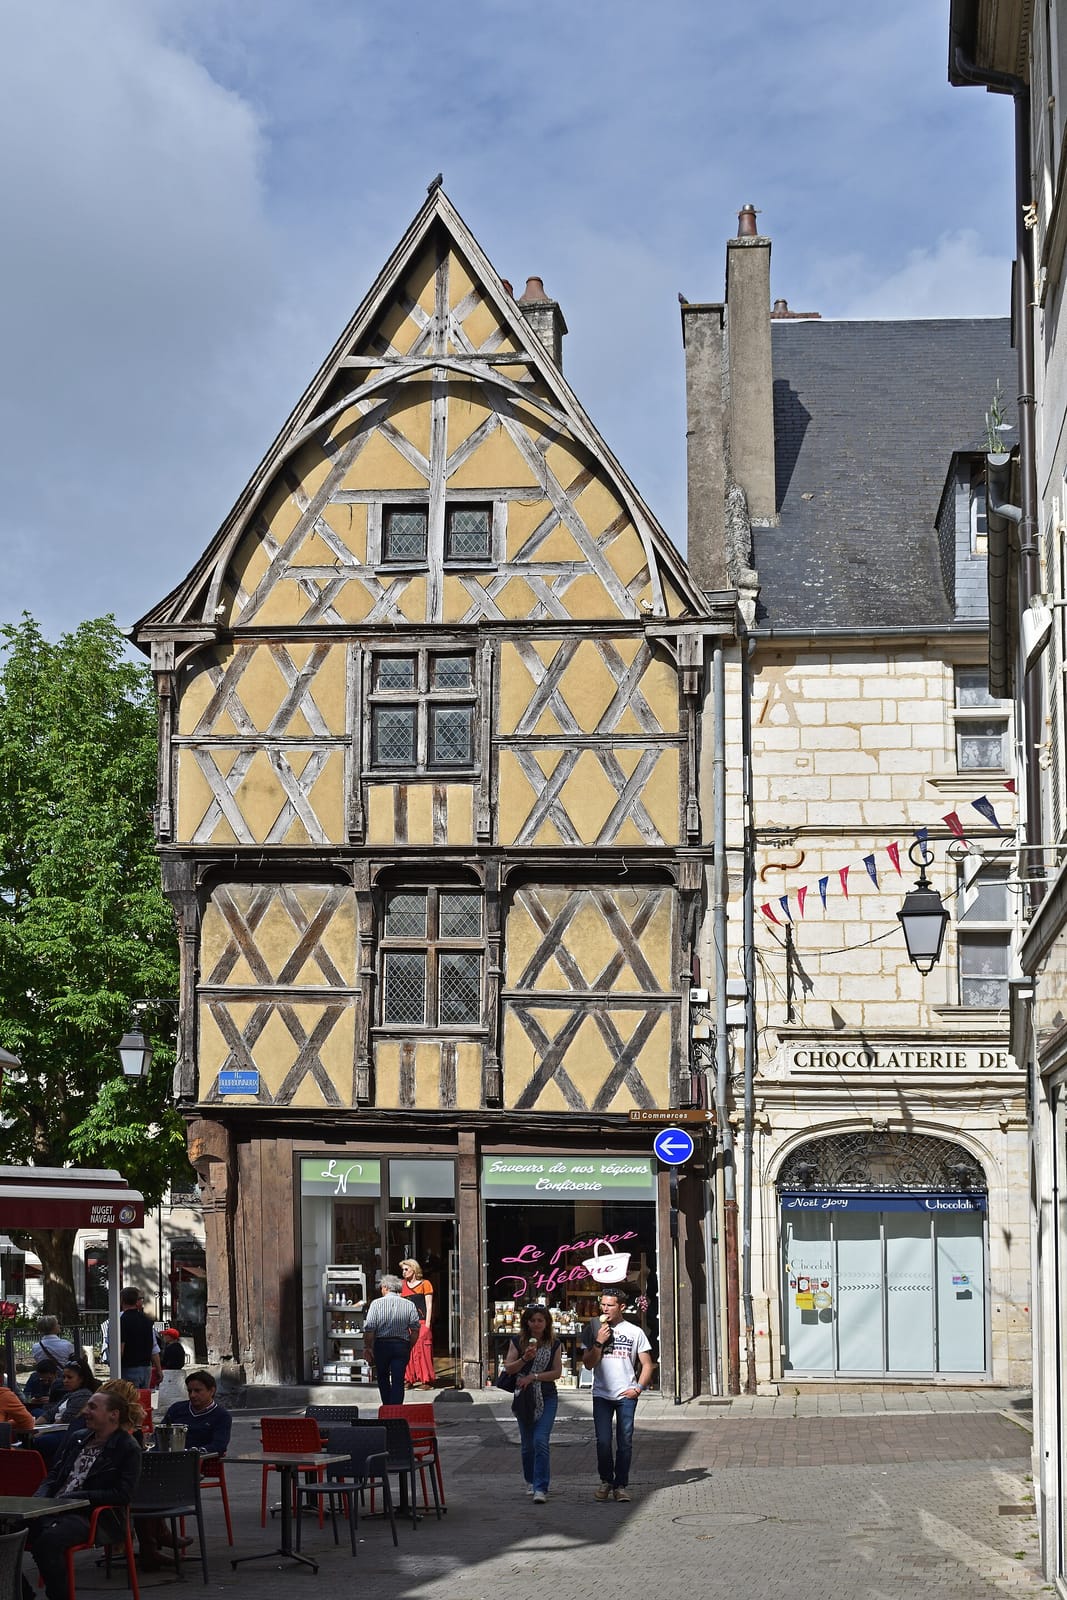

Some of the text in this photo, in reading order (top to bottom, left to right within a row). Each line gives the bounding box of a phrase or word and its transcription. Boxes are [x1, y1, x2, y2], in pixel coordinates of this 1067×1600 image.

[793, 1050, 1008, 1069] CHOCOLATERIE DE
[489, 1160, 649, 1177] Saveurs de nos régions
[535, 1177, 602, 1192] Confiserie
[91, 1205, 114, 1215] NUGET
[90, 1214, 115, 1224] NAVEAU
[501, 1231, 638, 1265] Le panier
